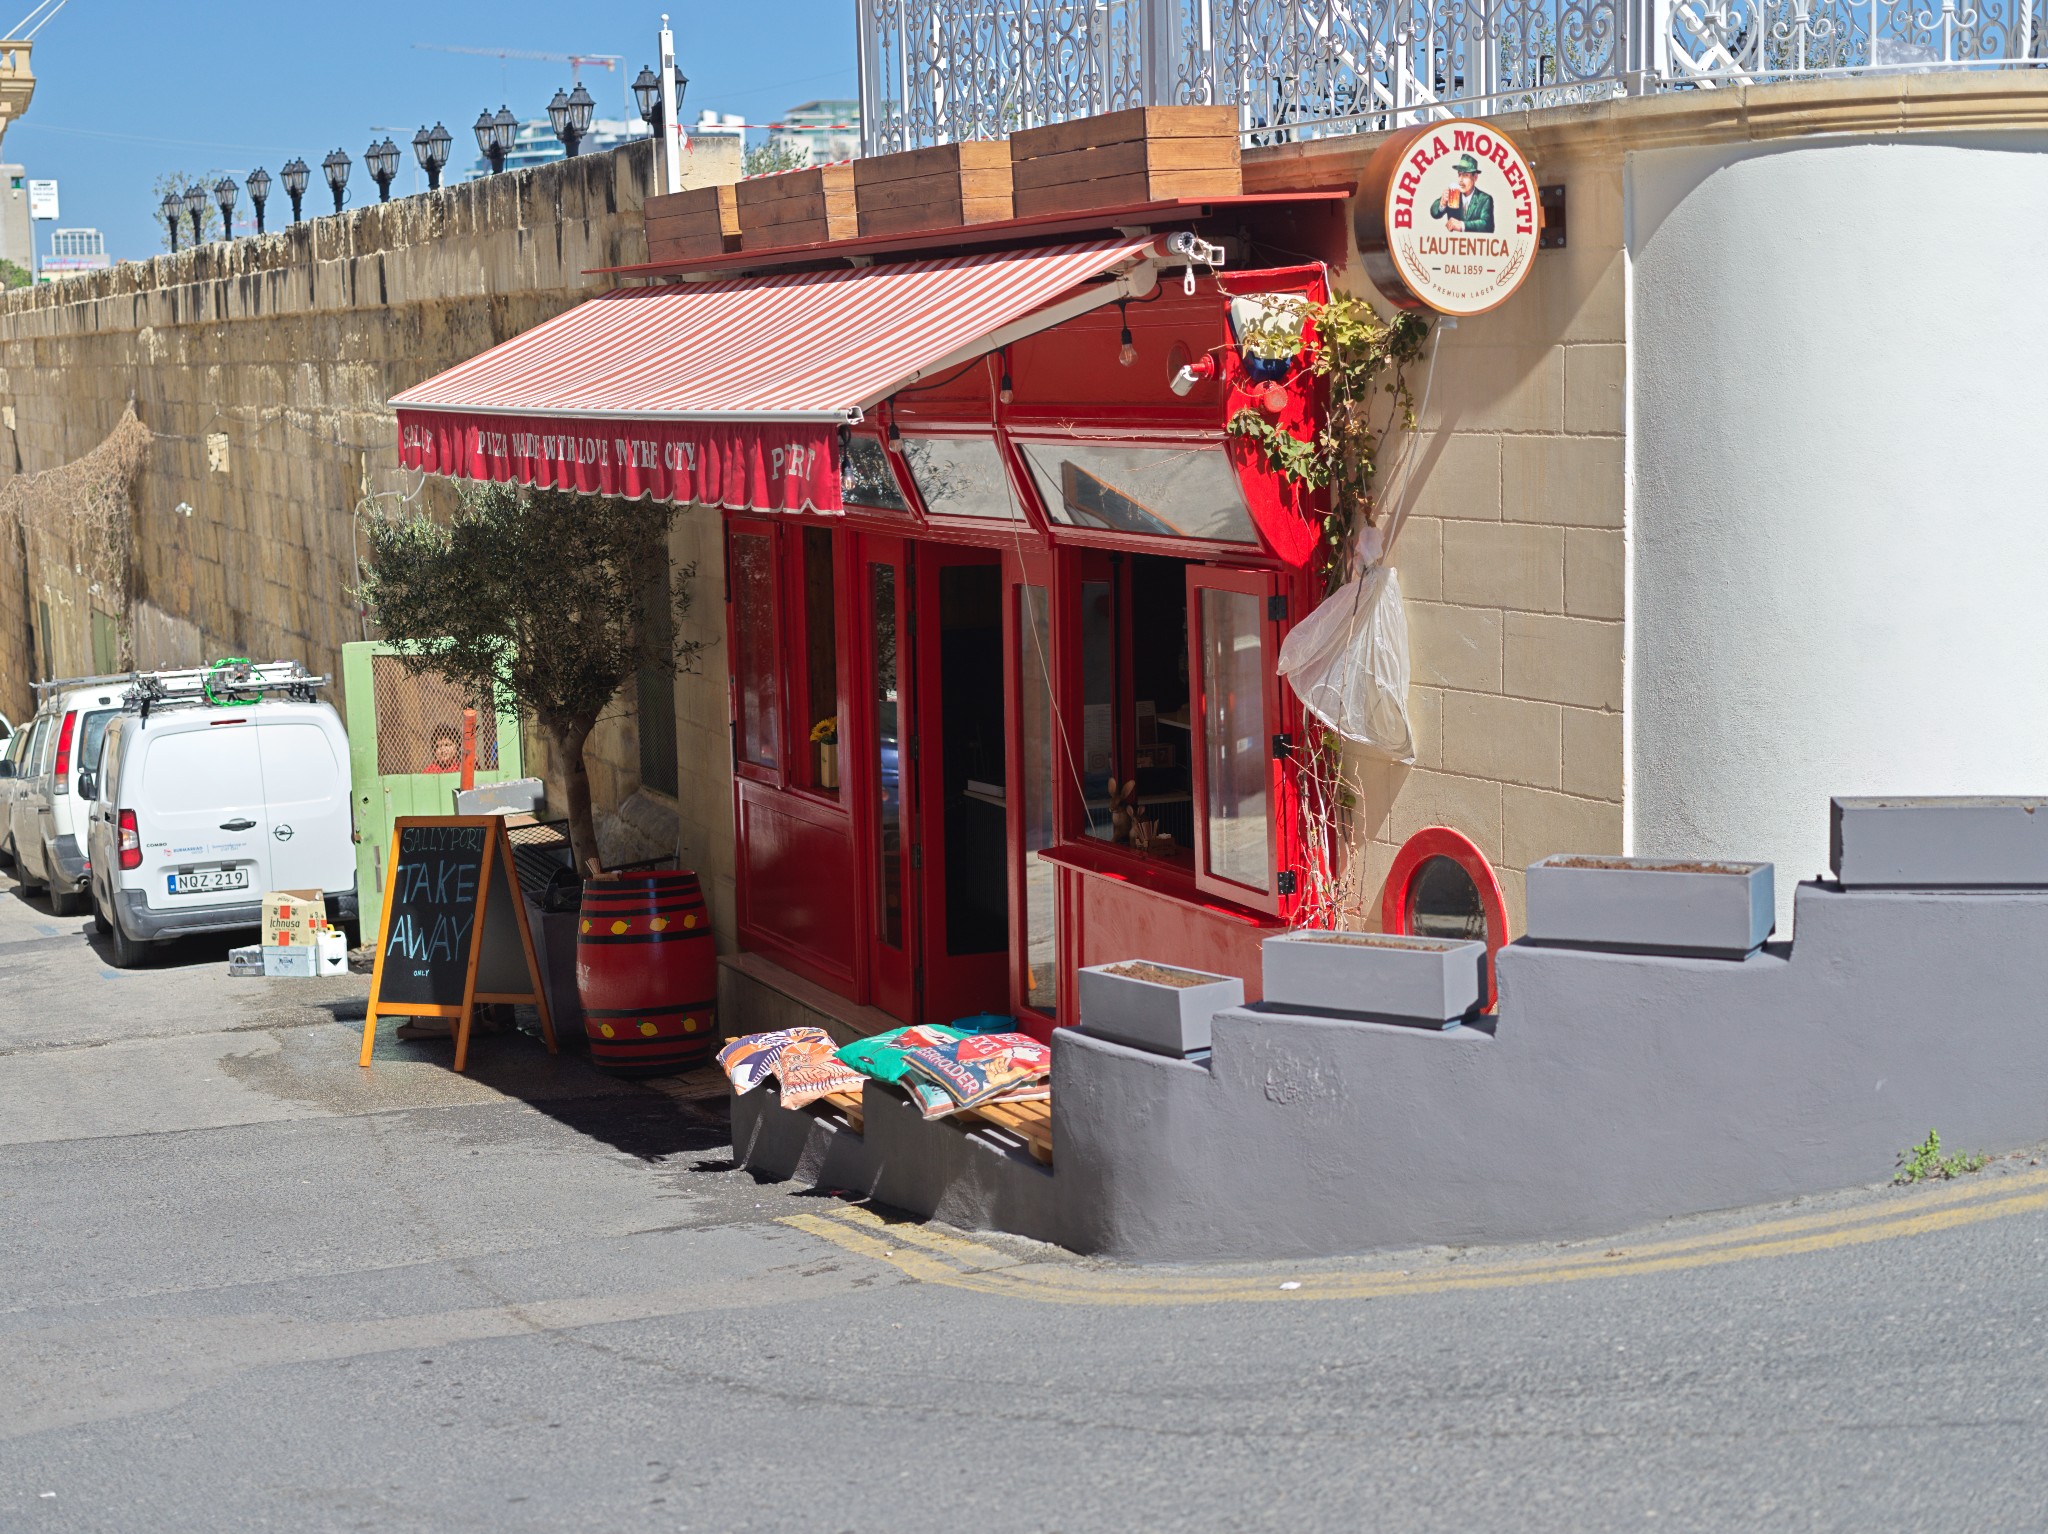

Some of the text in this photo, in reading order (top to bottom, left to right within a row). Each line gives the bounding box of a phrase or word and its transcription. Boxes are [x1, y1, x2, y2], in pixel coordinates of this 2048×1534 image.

[1394, 130, 1533, 235] BIRRA MORETTI
[1419, 236, 1509, 257] L'AUTENTICA
[1444, 264, 1483, 276] DAL 1859
[1432, 283, 1495, 299] PREMIUM LAGER
[631, 440, 658, 470] THE
[402, 827, 486, 853] SALLY PORT
[179, 872, 243, 889] NQZ 219
[397, 859, 476, 904] TAKE
[387, 912, 474, 963] AWAY
[413, 969, 430, 977] ONLY
